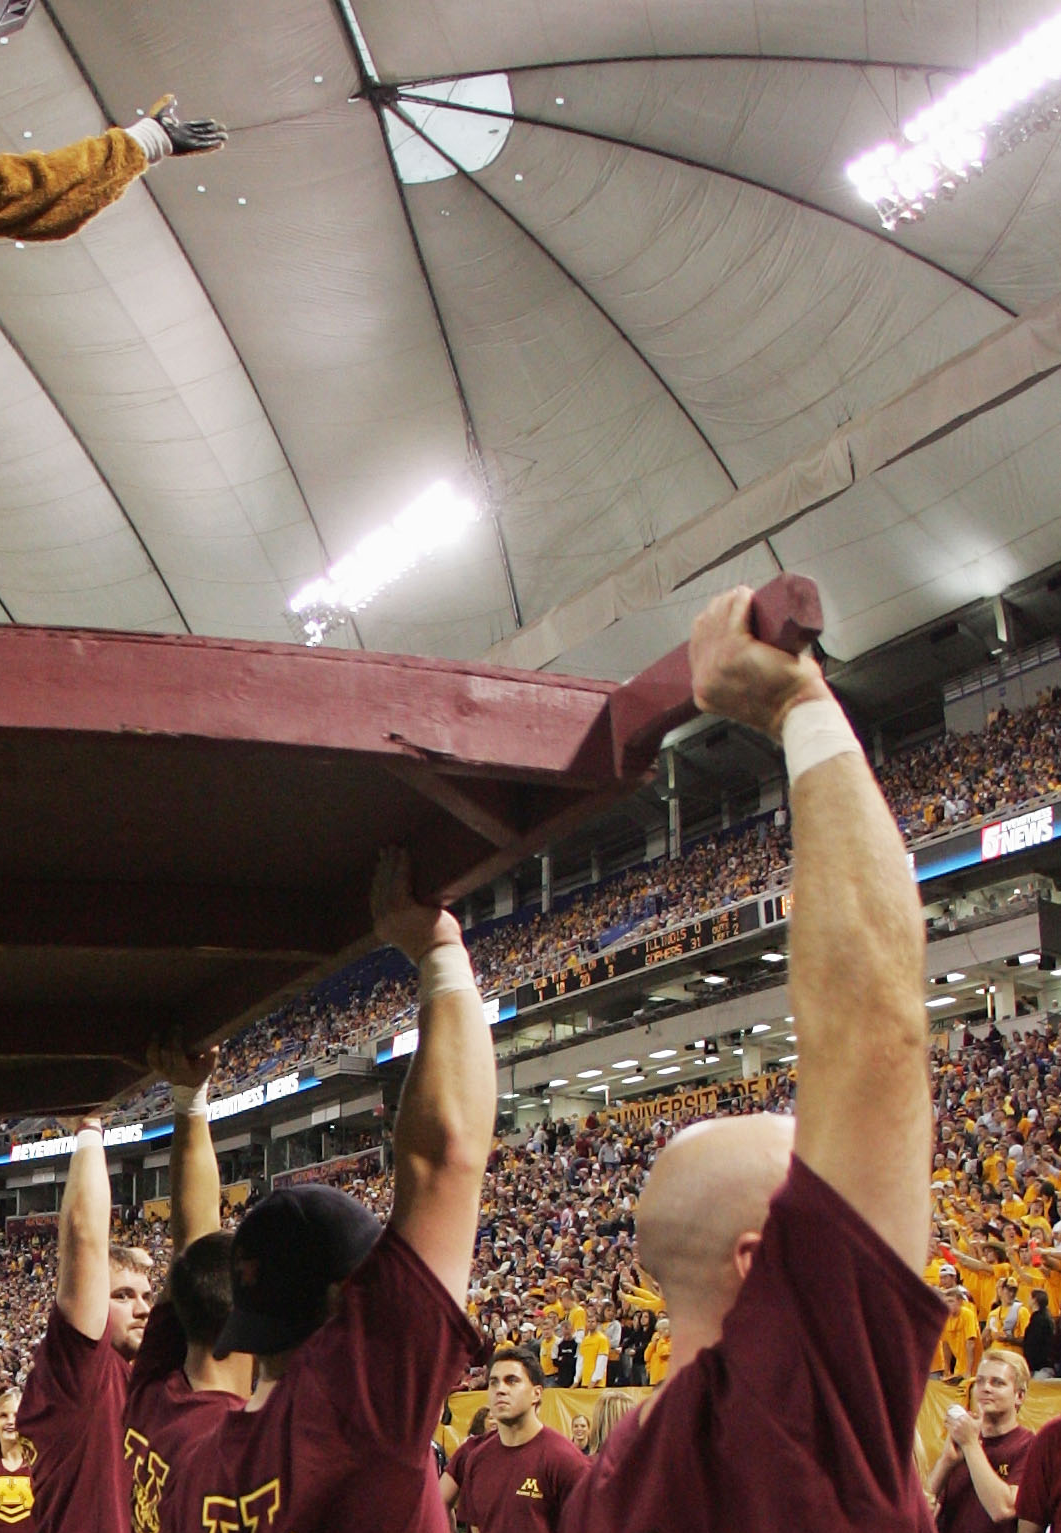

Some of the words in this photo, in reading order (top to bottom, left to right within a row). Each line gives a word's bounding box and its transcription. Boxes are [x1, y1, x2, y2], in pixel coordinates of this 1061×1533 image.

[1002, 818, 1054, 855] NEWS
[644, 943, 684, 966] GOPHERS
[690, 936, 702, 950] 31
[645, 928, 687, 952] ILLINOIS
[694, 921, 702, 934] 0
[580, 972, 591, 988] 20
[265, 1072, 299, 1103] NEWS
[616, 1089, 718, 1124] UNIVERSITY
[103, 1123, 143, 1147] NEWS
[521, 1477, 539, 1492] M
